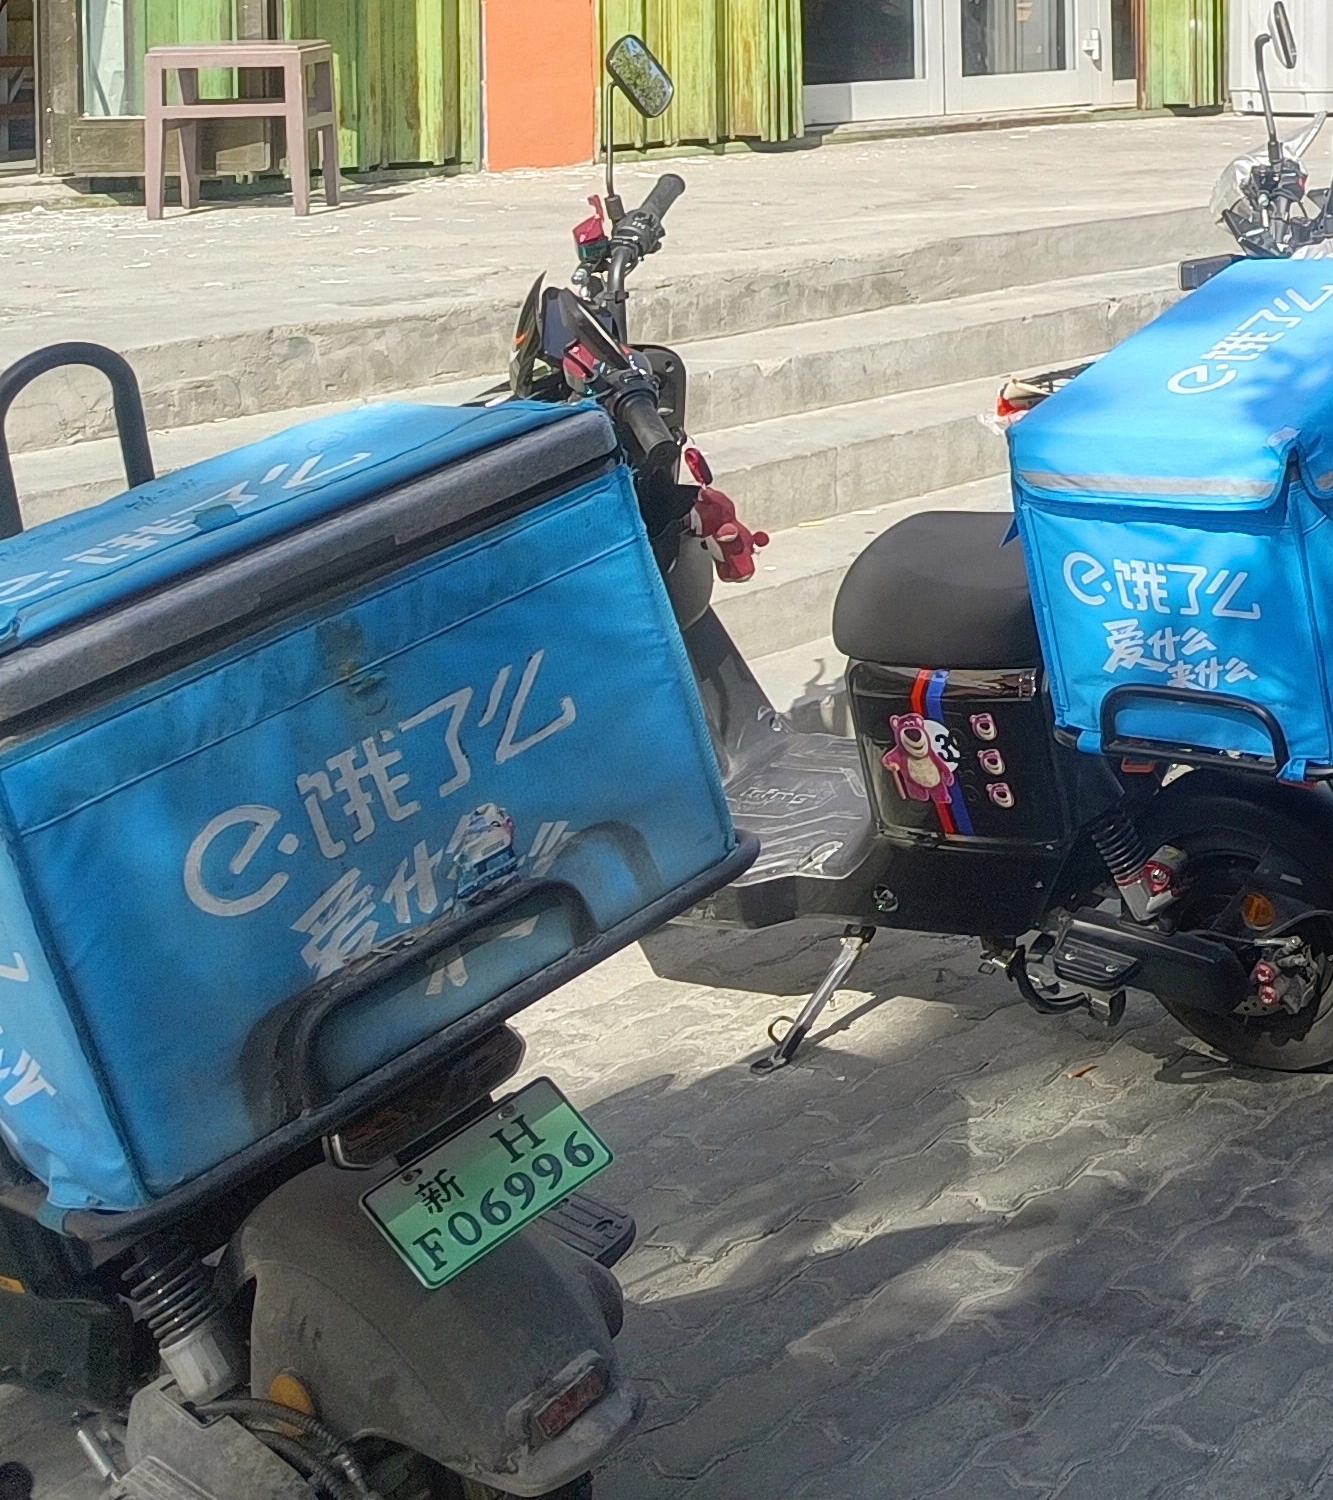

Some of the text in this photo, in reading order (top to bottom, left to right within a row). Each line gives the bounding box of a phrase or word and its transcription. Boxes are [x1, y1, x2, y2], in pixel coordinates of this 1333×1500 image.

[1102, 618, 1218, 674] 爱什么
[1166, 656, 1260, 692] 来什么
[411, 1130, 596, 1272] F06996
[414, 1114, 547, 1216] 新 H
